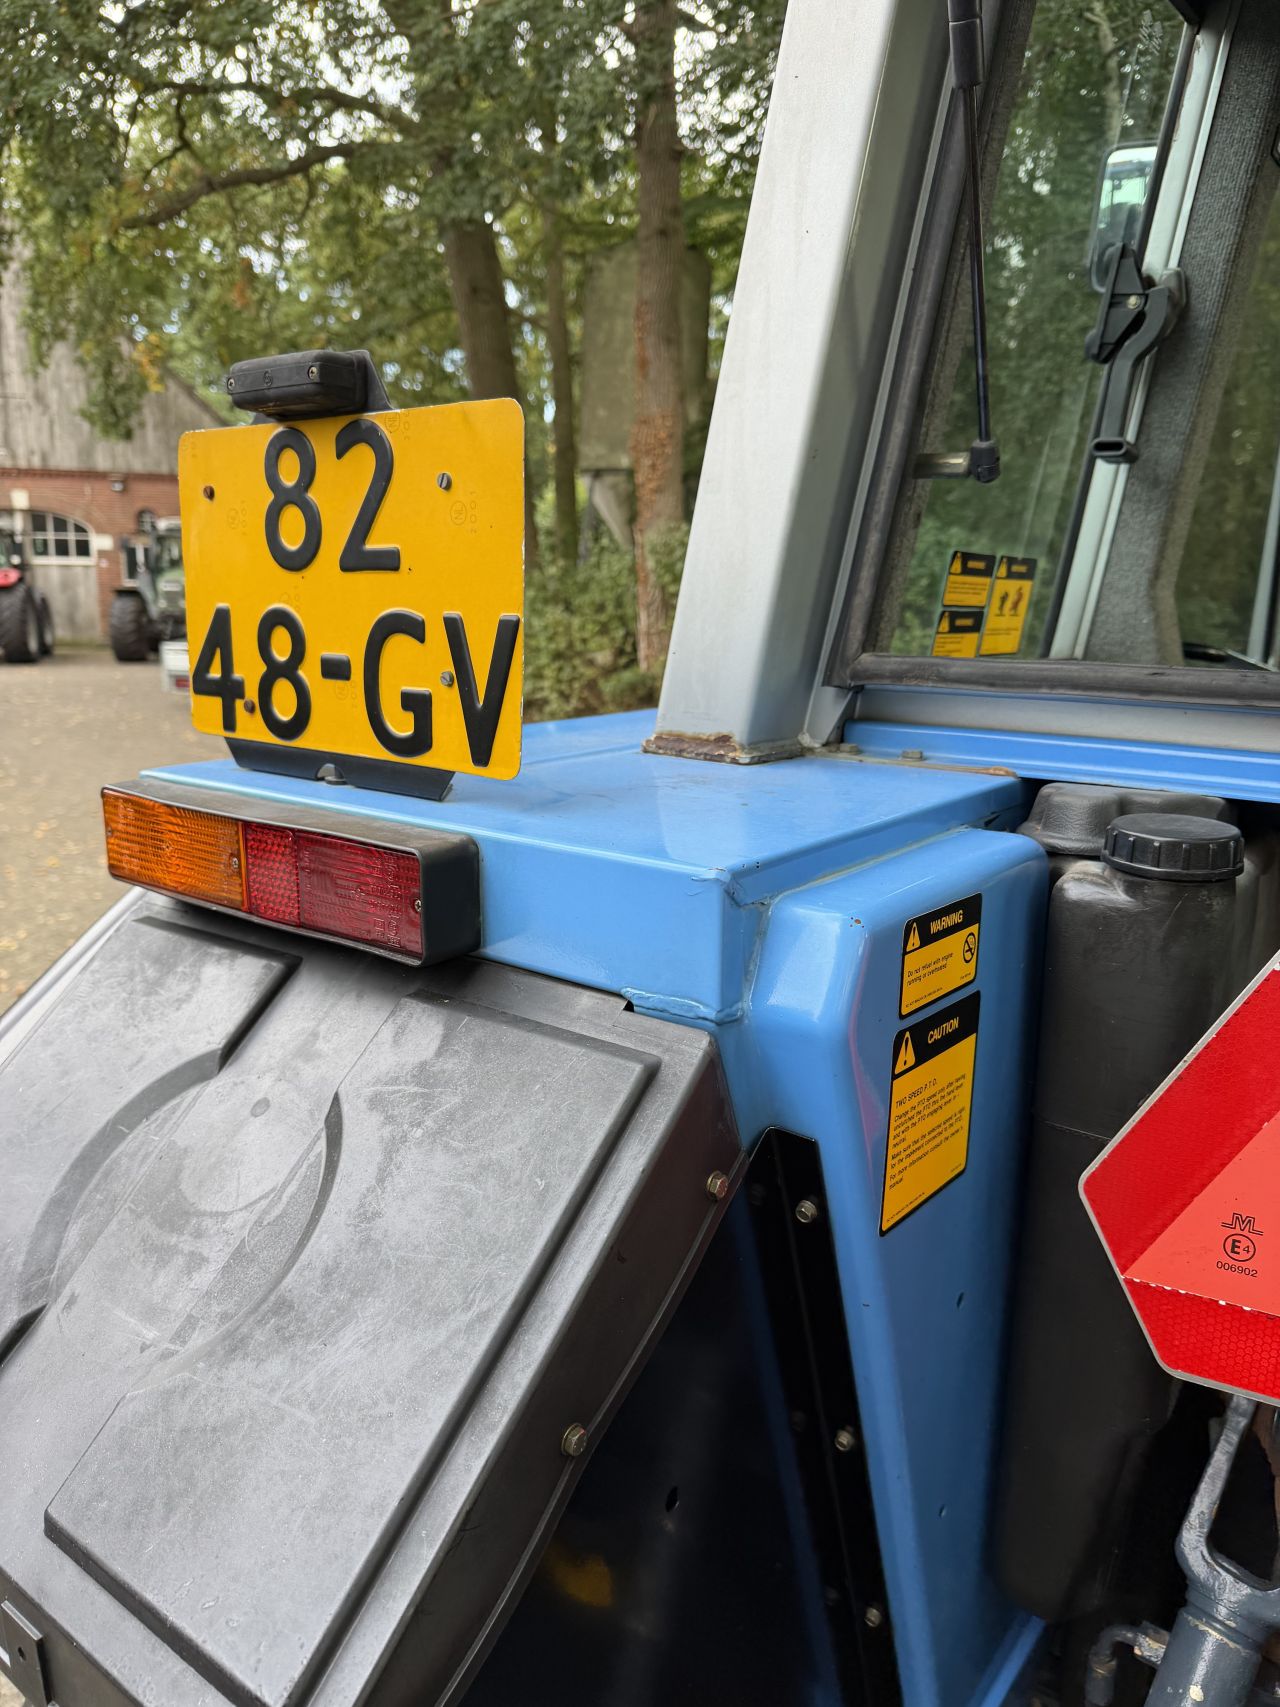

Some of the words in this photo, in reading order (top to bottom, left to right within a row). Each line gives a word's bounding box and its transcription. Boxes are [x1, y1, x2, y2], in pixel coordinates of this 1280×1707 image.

[264, 419, 400, 572] 82
[192, 603, 520, 767] 48-GV
[930, 910, 963, 934] WARNING
[933, 958, 941, 966] with
[942, 952, 953, 962] engine
[907, 976, 921, 986] running
[928, 1017, 959, 1044] CAUTION
[894, 1108, 910, 1123] Change
[917, 1099, 925, 1108] PTO
[926, 1091, 937, 1103] speed
[896, 1096, 907, 1109] TWO
[908, 1087, 923, 1101] SPEED
[923, 1103, 931, 1112] PTO
[893, 1131, 901, 1141] and
[902, 1125, 910, 1135] with
[918, 1115, 926, 1125] PTO
[892, 1150, 902, 1160] Make
[903, 1143, 911, 1153] sure
[898, 1165, 907, 1176] more
[1216, 1260, 1258, 1277] 006902
